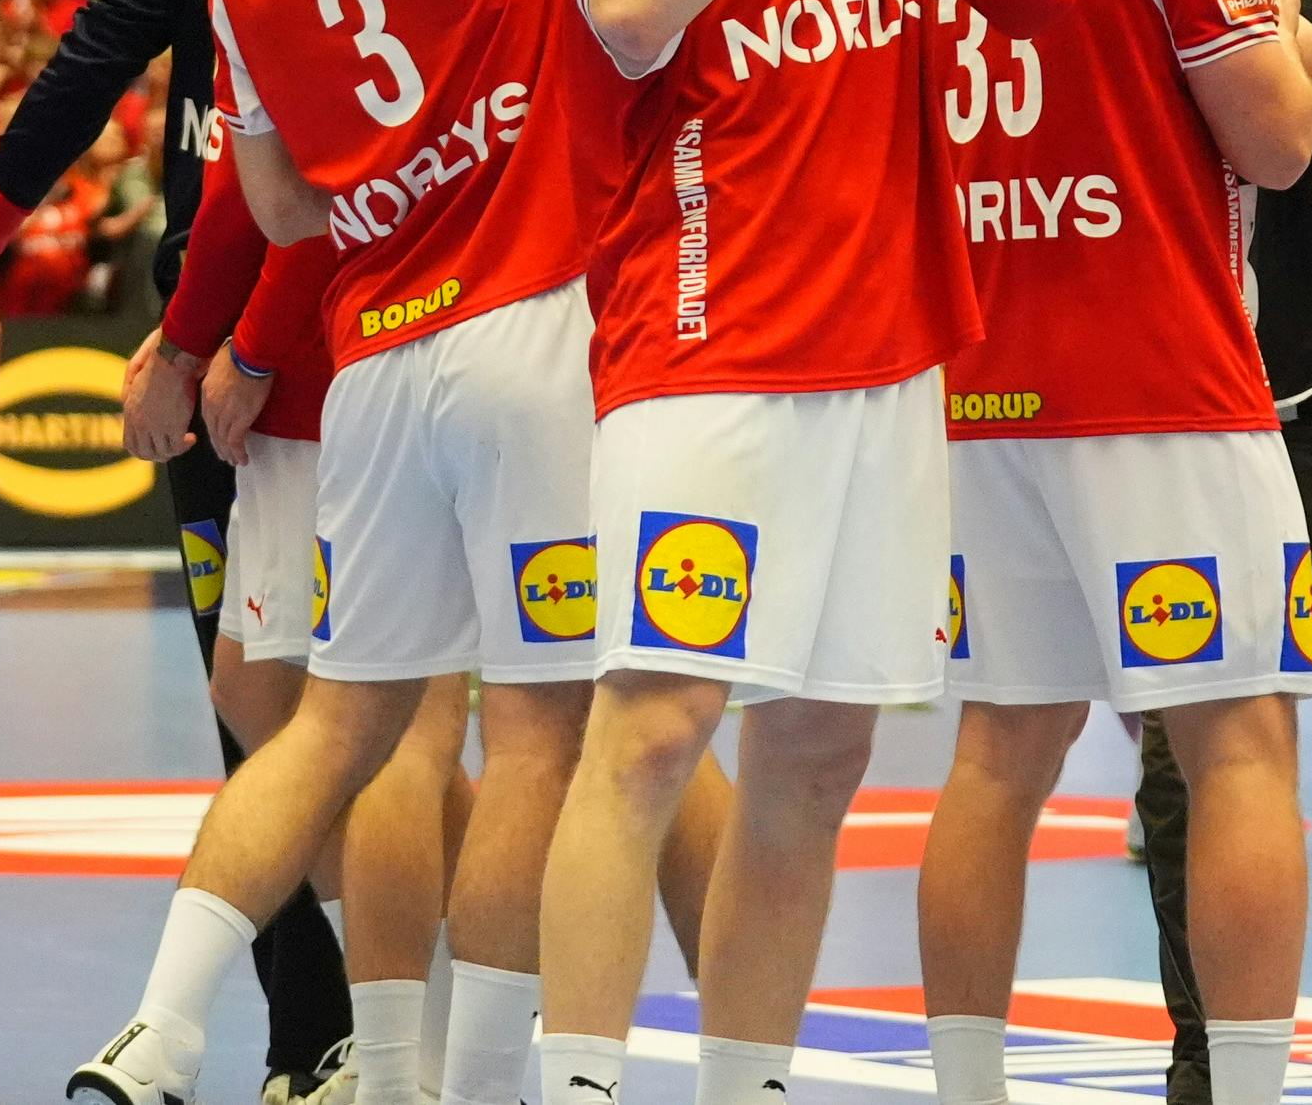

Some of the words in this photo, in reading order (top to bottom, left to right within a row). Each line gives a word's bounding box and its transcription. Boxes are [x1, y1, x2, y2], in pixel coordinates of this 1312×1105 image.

[673, 118, 708, 341] #SAMMENFORHOLDET
[955, 174, 1122, 243] RLYS
[360, 278, 461, 337] BORUP
[950, 392, 1042, 420] BORUP
